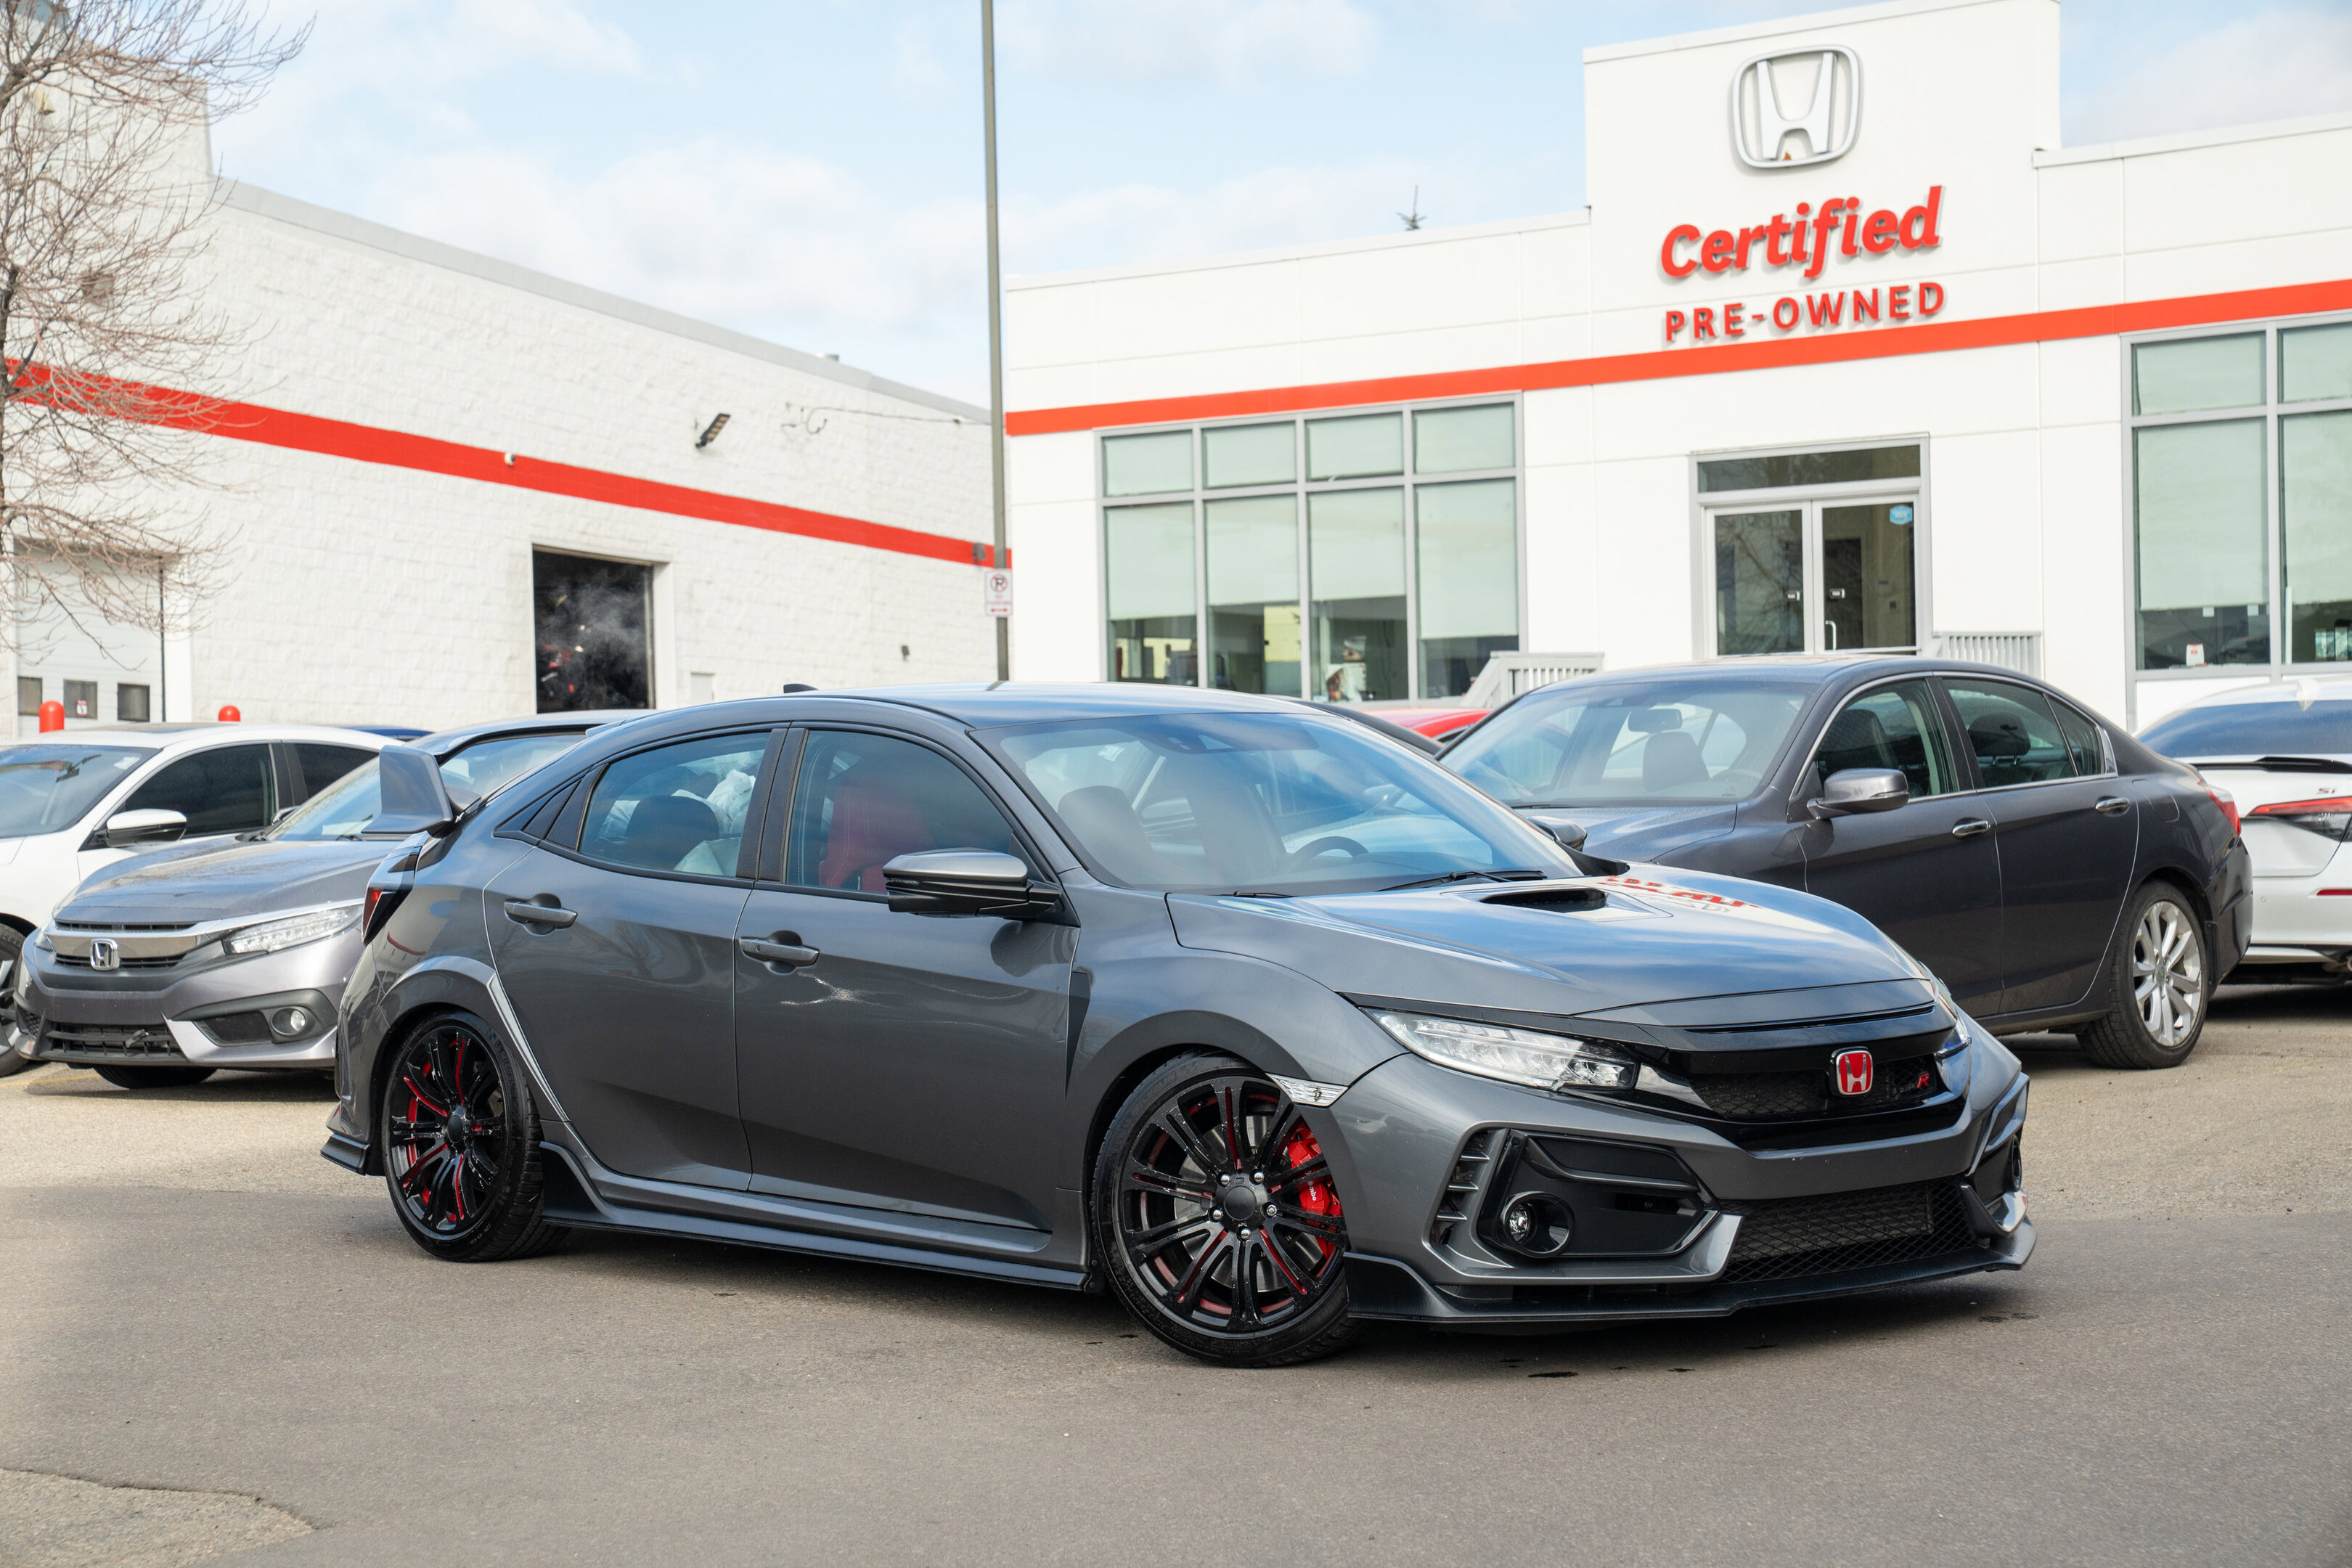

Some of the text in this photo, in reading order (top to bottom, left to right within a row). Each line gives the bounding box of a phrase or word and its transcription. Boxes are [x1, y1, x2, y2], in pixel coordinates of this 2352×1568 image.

[1660, 185, 1943, 279] Certified
[1665, 282, 1945, 342] PRE-OWNED
[1916, 1073, 1930, 1088] R
